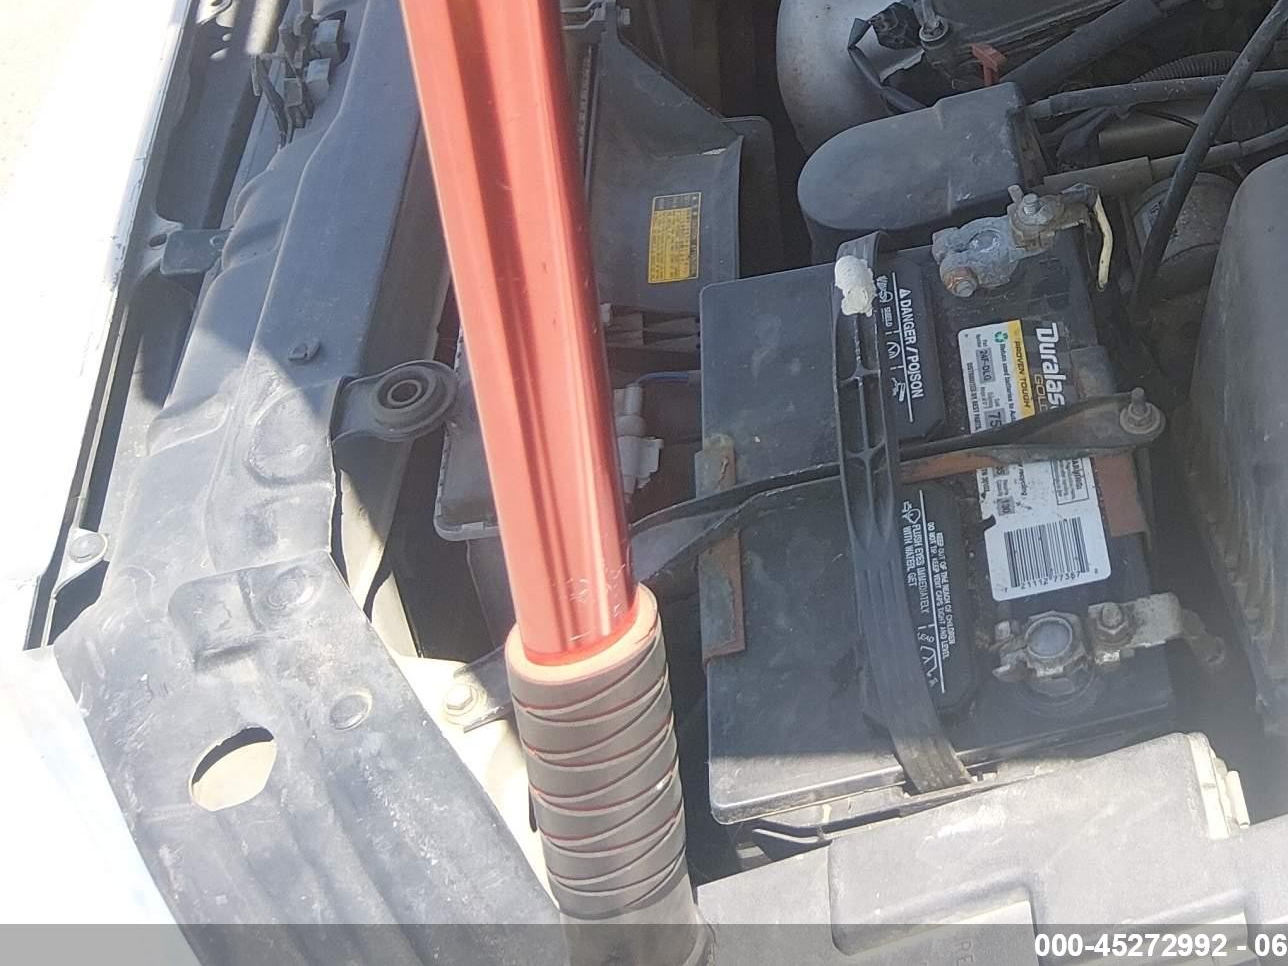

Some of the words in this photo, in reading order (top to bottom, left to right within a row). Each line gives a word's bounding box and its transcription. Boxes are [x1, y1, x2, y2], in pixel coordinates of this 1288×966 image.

[1013, 341, 1026, 375] PROVEN
[1020, 378, 1031, 409] TOUGH
[988, 412, 1002, 427] 75
[903, 526, 912, 543] WITH
[912, 524, 922, 546] FLUSH
[928, 522, 934, 531] DO
[915, 548, 925, 566] EYES
[940, 561, 947, 570] OF
[907, 573, 917, 587] GET
[917, 567, 930, 614] IMMEDIATELY
[937, 607, 945, 624] TIGHT
[939, 626, 947, 640] AND
